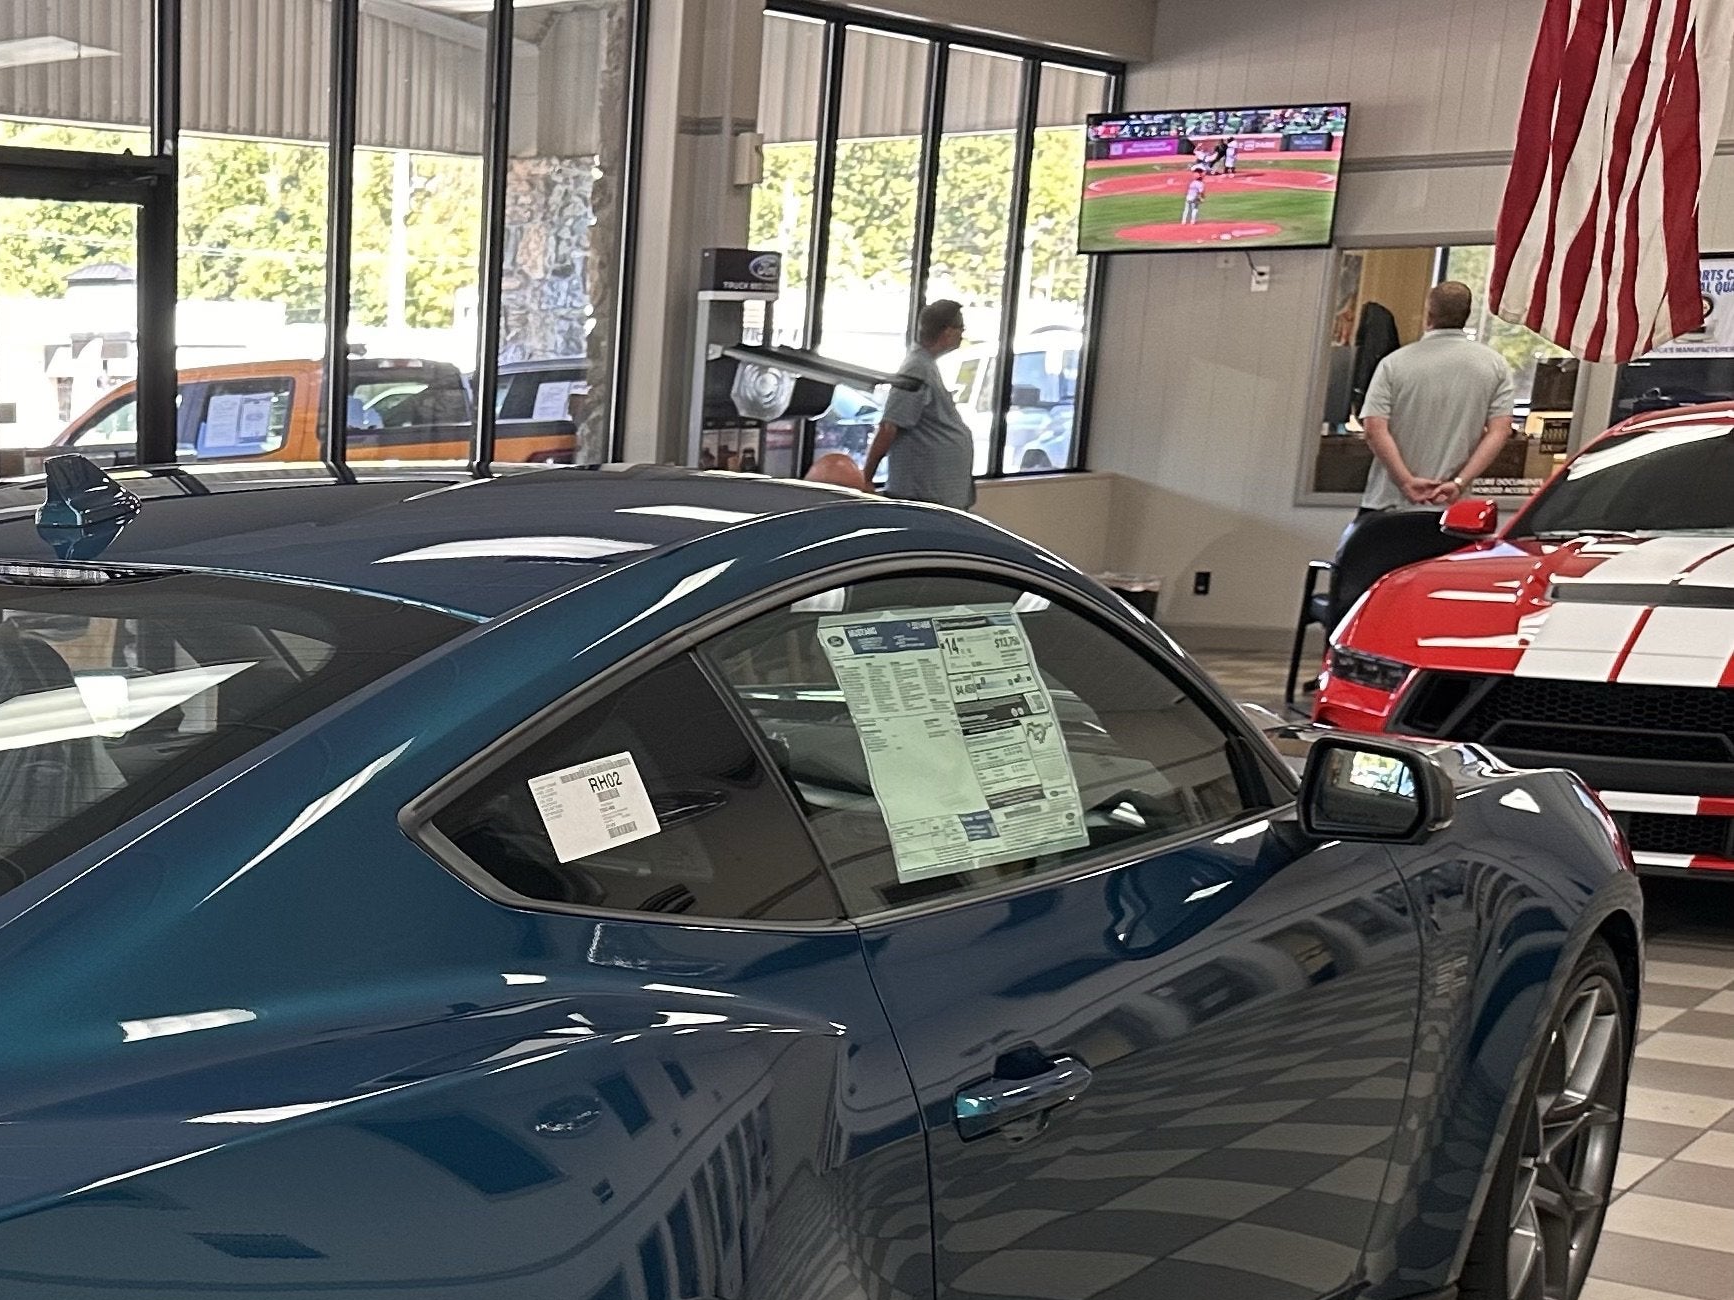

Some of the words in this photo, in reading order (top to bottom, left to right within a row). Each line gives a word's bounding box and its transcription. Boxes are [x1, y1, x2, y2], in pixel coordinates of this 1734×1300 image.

[1701, 269, 1724, 281] RTS
[945, 637, 960, 656] 14
[588, 771, 623, 793] RH02
